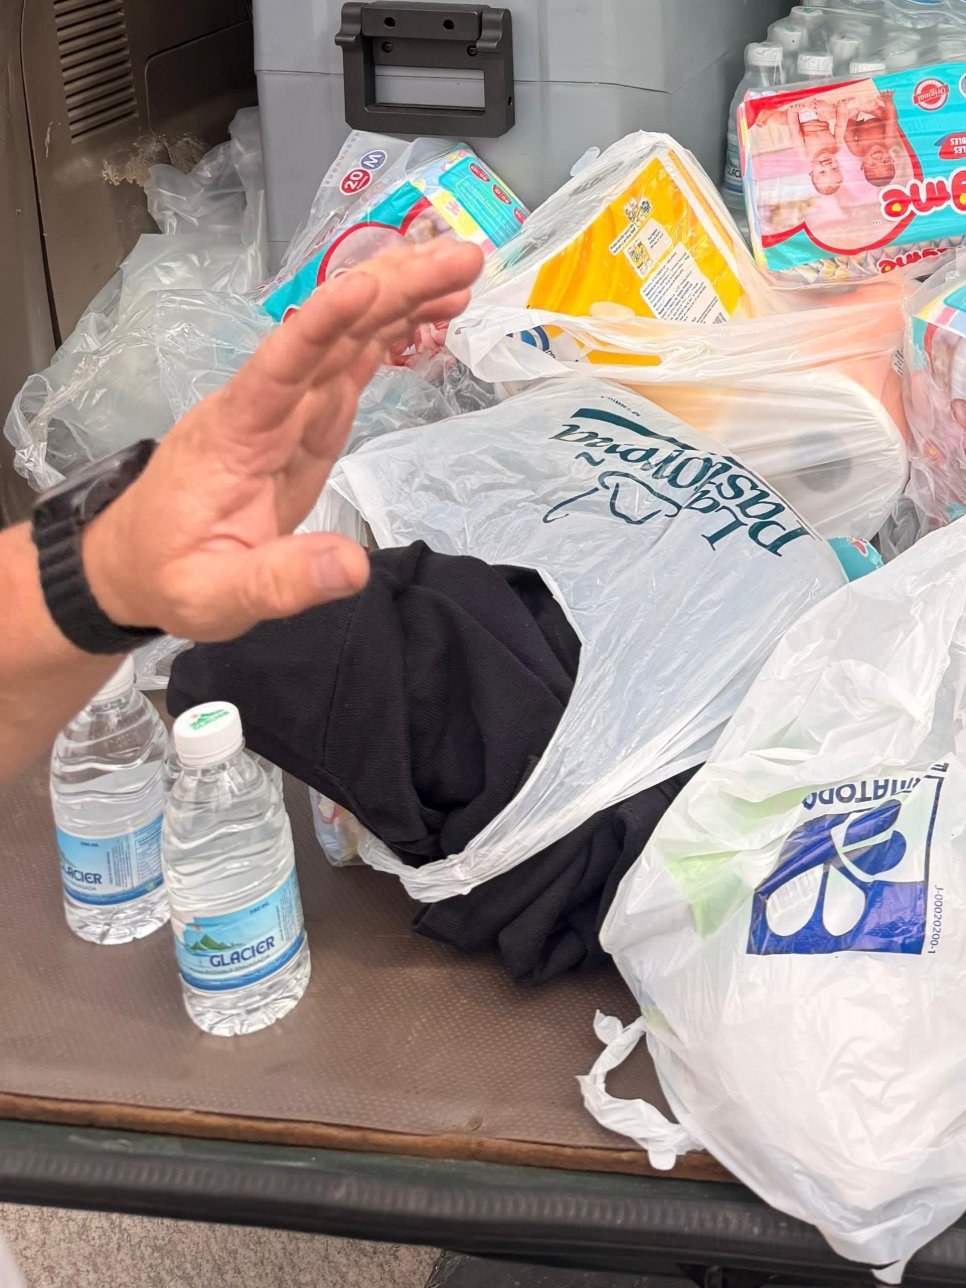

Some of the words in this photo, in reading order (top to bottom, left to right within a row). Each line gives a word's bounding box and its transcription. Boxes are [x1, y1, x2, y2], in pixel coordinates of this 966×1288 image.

[917, 86, 946, 103] Original
[363, 154, 382, 168] M
[343, 171, 362, 190] 20
[682, 490, 748, 552] La
[927, 885, 944, 954] J-00020200-1
[209, 935, 275, 968] GLACIER
